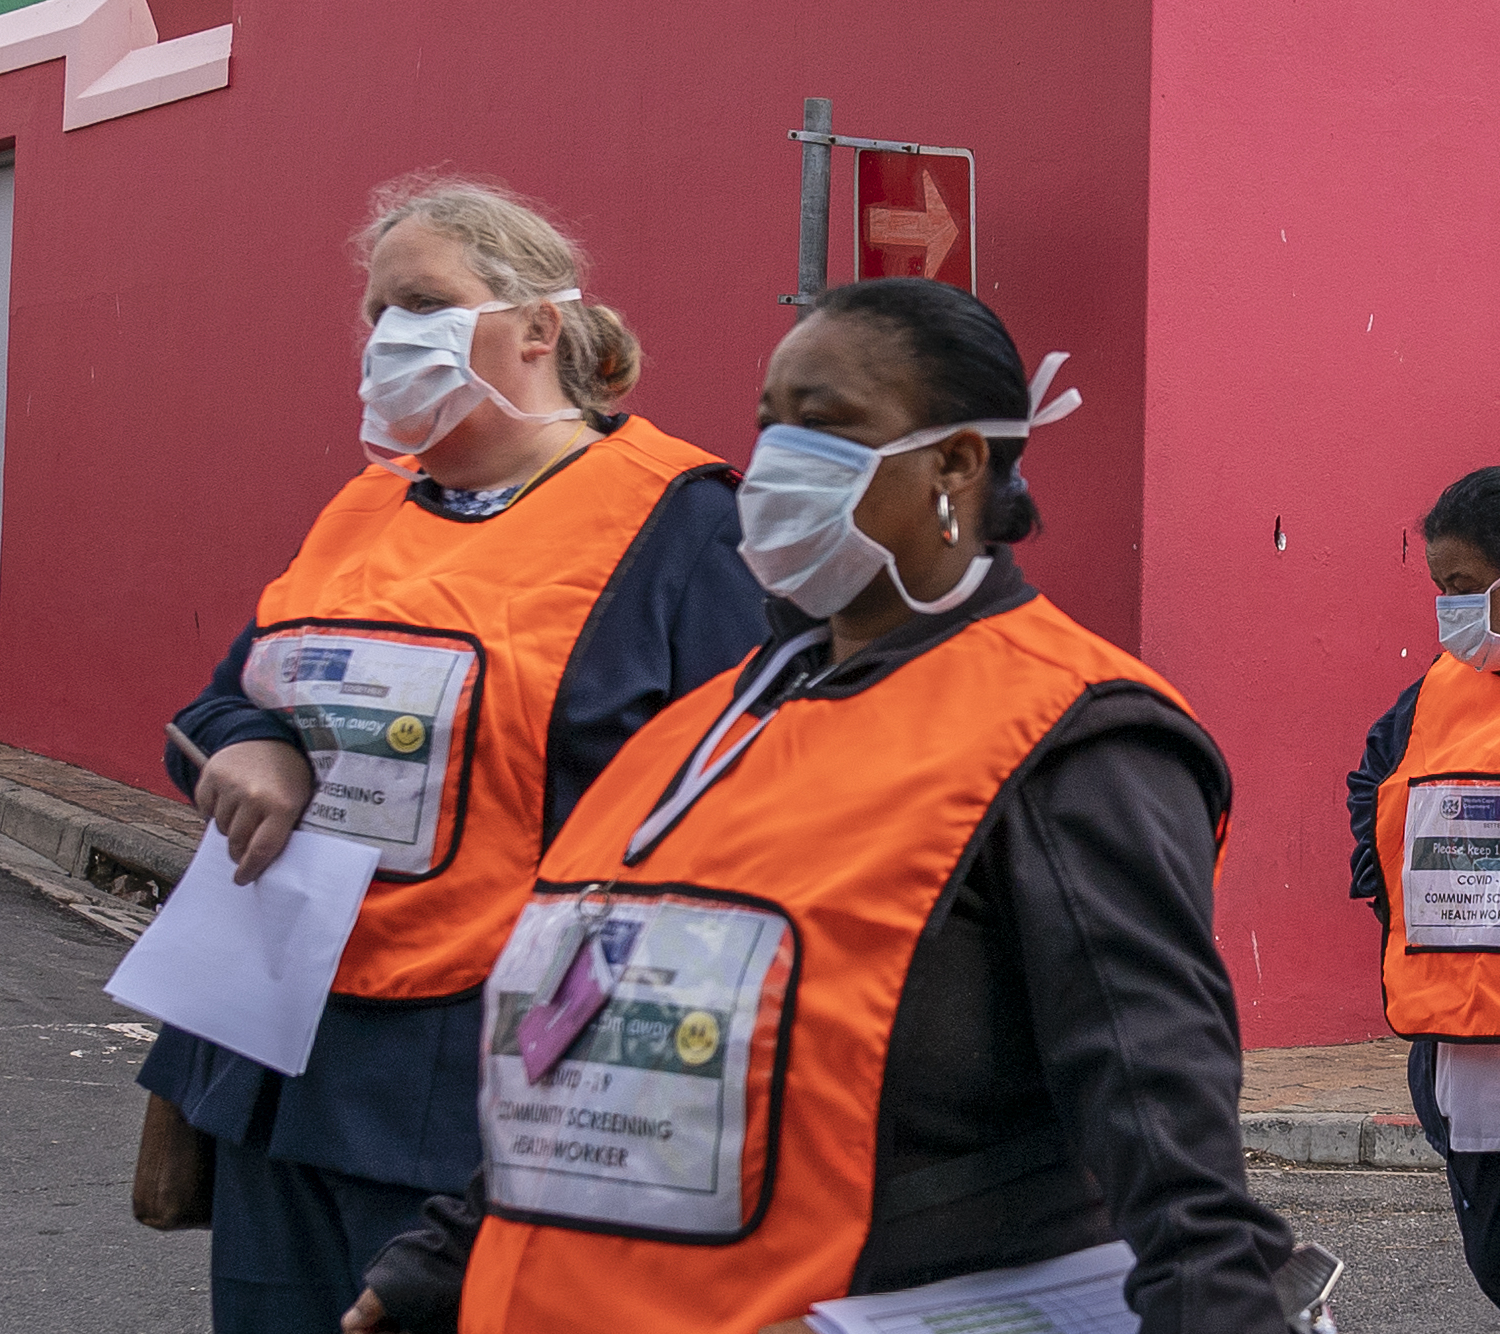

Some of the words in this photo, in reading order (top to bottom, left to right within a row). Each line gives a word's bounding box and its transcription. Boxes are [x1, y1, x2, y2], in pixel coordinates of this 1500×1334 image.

[346, 718, 386, 736] away
[1432, 842, 1463, 855] Please
[1467, 844, 1491, 856] keep
[1457, 875, 1492, 886] COVID
[1424, 892, 1484, 905] COMMUNITY
[1441, 909, 1478, 920] HEALTH
[567, 1106, 674, 1142] SCREENING
[554, 1140, 629, 1168] WORKER
